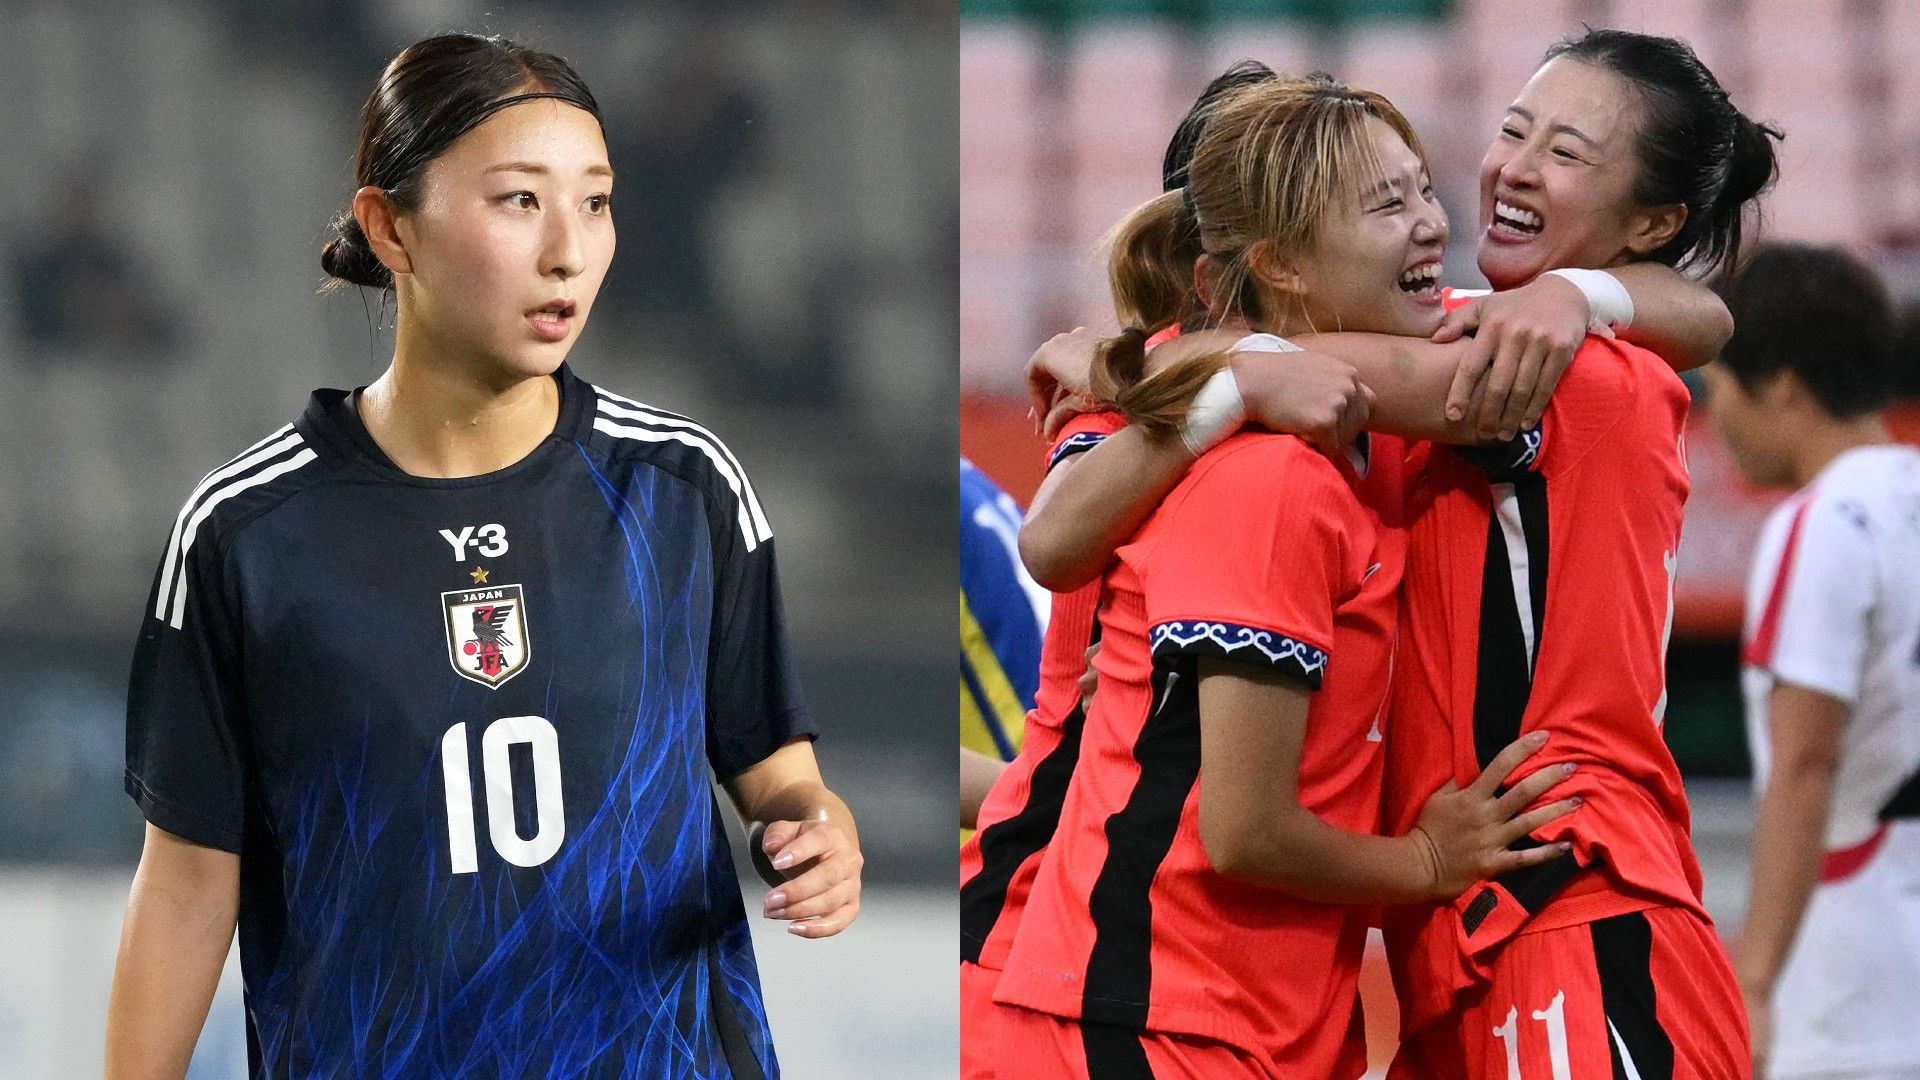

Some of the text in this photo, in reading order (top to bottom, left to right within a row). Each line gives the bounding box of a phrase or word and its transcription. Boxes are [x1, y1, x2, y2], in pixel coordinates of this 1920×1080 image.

[439, 523, 509, 562] Y-3
[462, 590, 503, 602] JAPAN
[474, 653, 509, 671] JFA
[441, 715, 566, 874] 10
[1492, 988, 1572, 1080] 11
